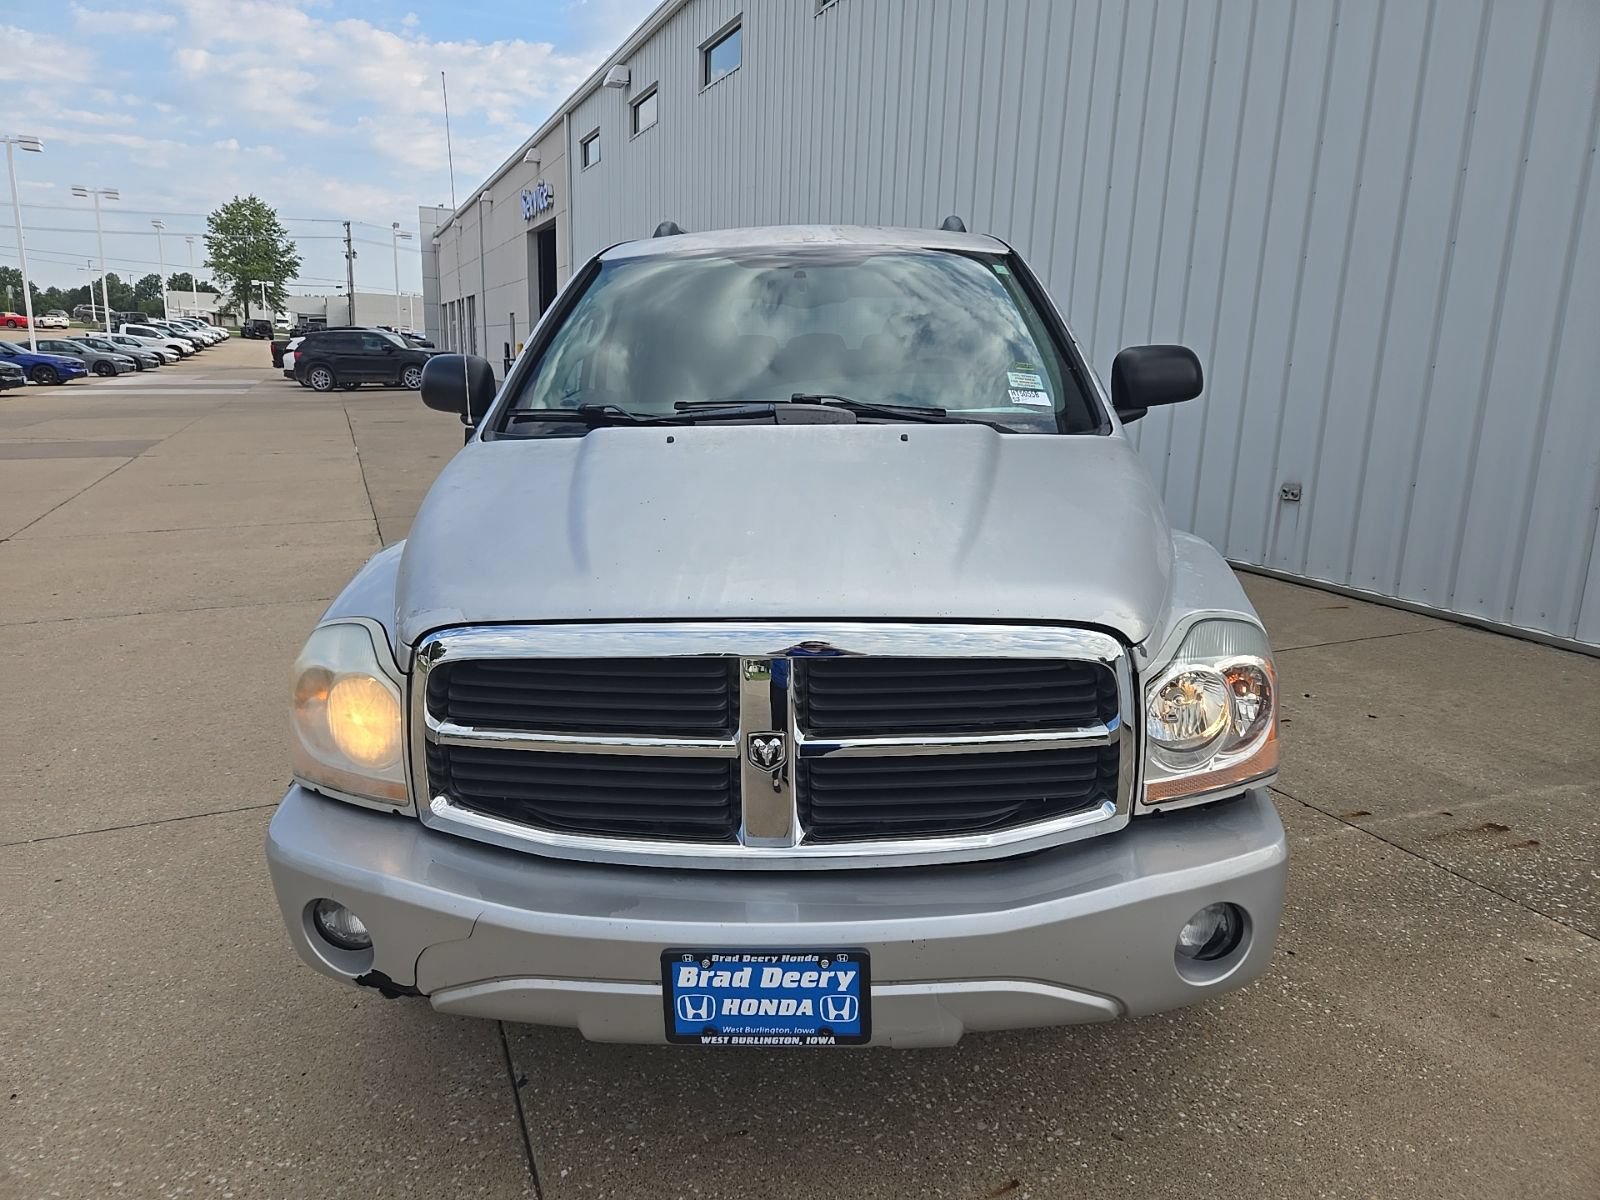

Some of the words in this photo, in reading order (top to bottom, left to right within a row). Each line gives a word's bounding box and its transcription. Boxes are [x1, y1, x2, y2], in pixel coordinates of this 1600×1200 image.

[711, 954, 740, 962] Brad
[742, 954, 779, 964] Deery
[781, 954, 819, 962] Honda
[677, 966, 753, 988] Brad
[759, 966, 857, 992] Deery
[721, 998, 814, 1016] HONDA
[722, 1026, 743, 1034] West
[744, 1026, 793, 1036] Burlington,
[794, 1026, 816, 1034] Iowa
[701, 1036, 730, 1044] WEST
[731, 1036, 804, 1045] BURLINGTON,
[805, 1036, 837, 1045] IOWA
